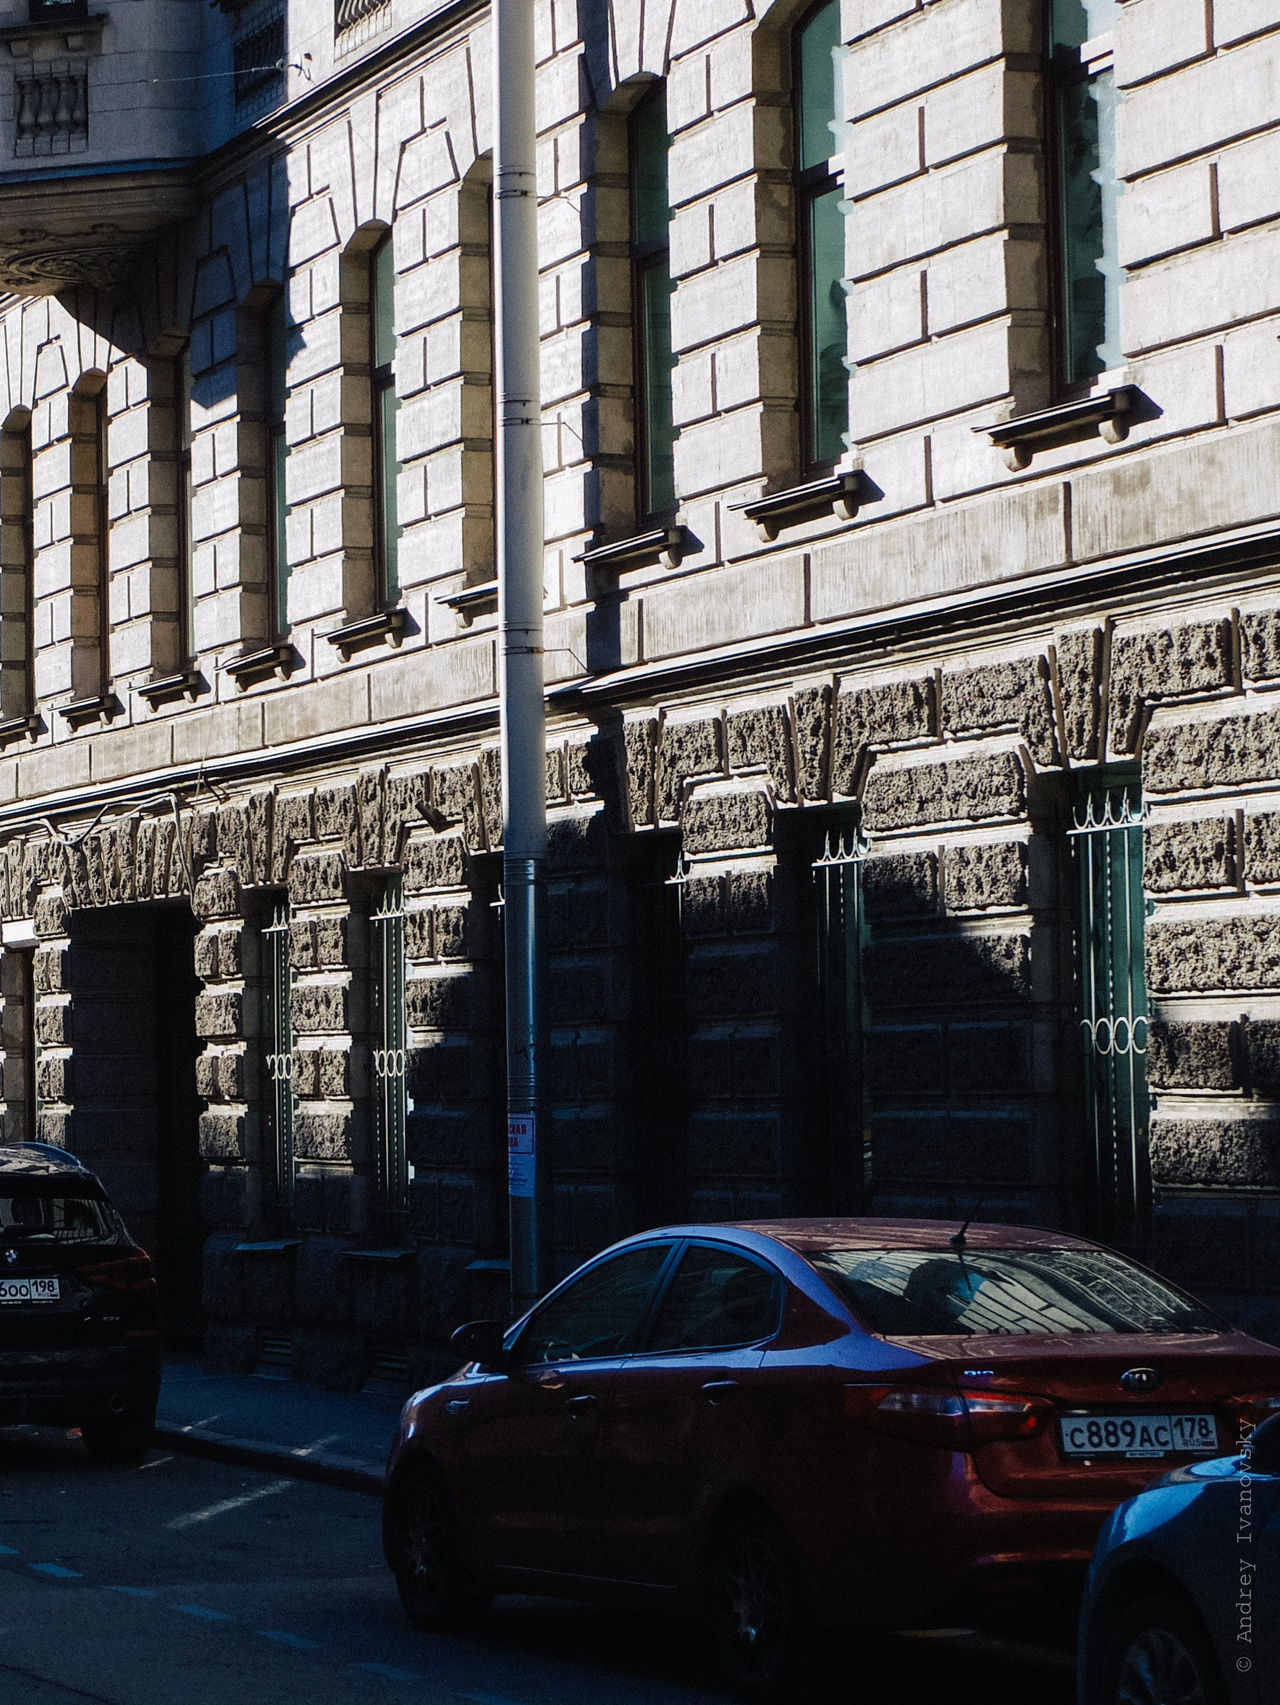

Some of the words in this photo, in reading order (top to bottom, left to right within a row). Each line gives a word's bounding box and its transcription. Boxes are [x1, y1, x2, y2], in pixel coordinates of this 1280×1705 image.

[31, 1280, 56, 1293] 198
[1173, 1417, 1209, 1438] 178
[1182, 1438, 1202, 1447] RUS
